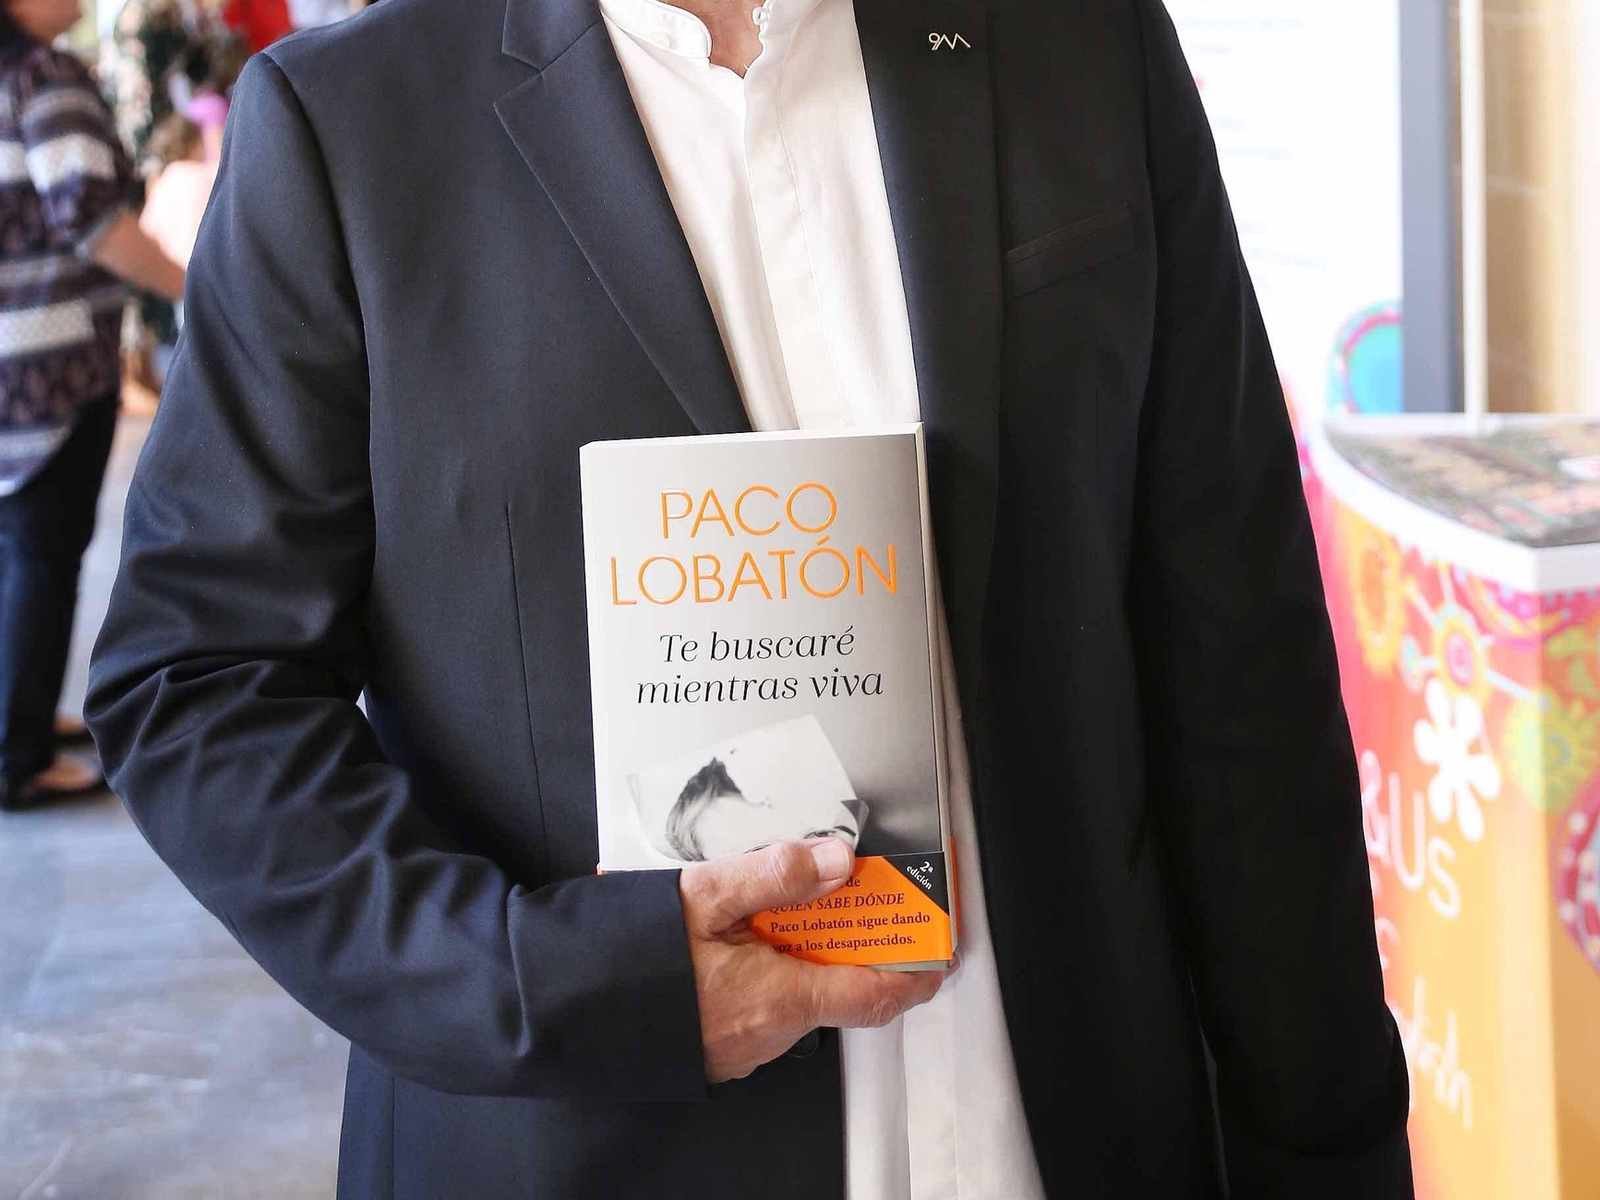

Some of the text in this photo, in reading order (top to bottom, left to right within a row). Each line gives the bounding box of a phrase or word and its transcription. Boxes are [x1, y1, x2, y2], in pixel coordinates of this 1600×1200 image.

[660, 482, 837, 539] PACO
[610, 535, 898, 605] LOBATÓN
[659, 625, 855, 663] Te buscaré
[637, 668, 883, 704] mientras viva
[906, 865, 932, 890] edición
[816, 897, 851, 910] SABE
[854, 892, 905, 908] DÓNDE
[770, 912, 931, 933] Paco Lobatón sigue dando
[796, 943, 803, 952] a
[805, 939, 823, 951] los
[826, 933, 916, 952] desaparecidos.
